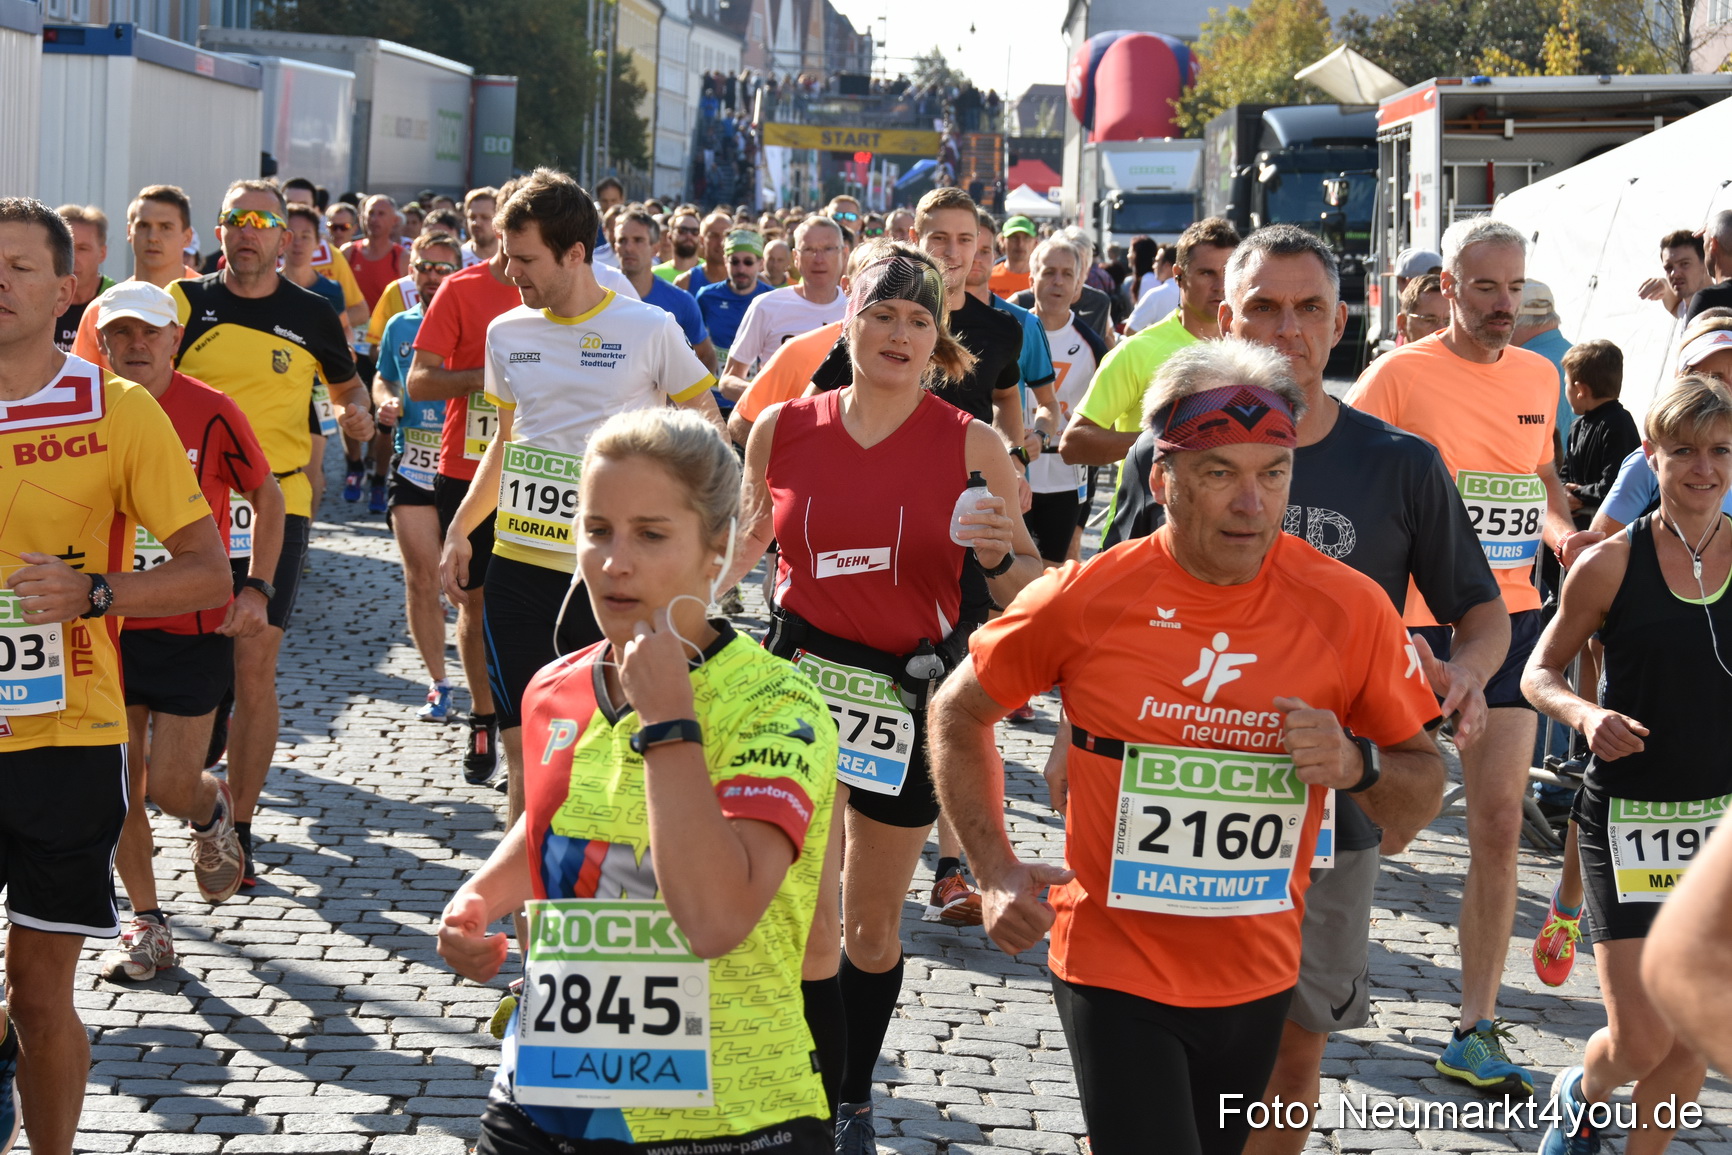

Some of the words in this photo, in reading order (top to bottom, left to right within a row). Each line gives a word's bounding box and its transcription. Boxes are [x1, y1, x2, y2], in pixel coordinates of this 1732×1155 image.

[822, 131, 881, 147] START
[202, 314, 218, 322] erima
[194, 331, 220, 353] Markus
[582, 337, 600, 350] 20
[510, 352, 540, 360] BOCK
[580, 360, 616, 370] Stadtlauf
[581, 351, 627, 360] Neumarkter
[1517, 414, 1545, 425] THULE
[13, 432, 108, 466] BÖGL
[511, 450, 582, 479] BOCK
[509, 479, 579, 519] 1199
[1466, 479, 1541, 498] BOCK
[508, 518, 569, 540] FLORIAN
[1467, 506, 1540, 536] 2538
[836, 555, 870, 568] DEHN
[1149, 619, 1182, 629] erima
[798, 660, 898, 704] BOCK
[1138, 696, 1280, 728] funrunners
[1142, 757, 1288, 794] BOCK
[1623, 798, 1724, 817] BOCK
[1138, 805, 1283, 860] 2160
[1136, 869, 1270, 897] HARTMUT
[538, 916, 678, 948] BOCK
[534, 973, 681, 1036] 2845
[551, 1050, 682, 1084] LAURA
